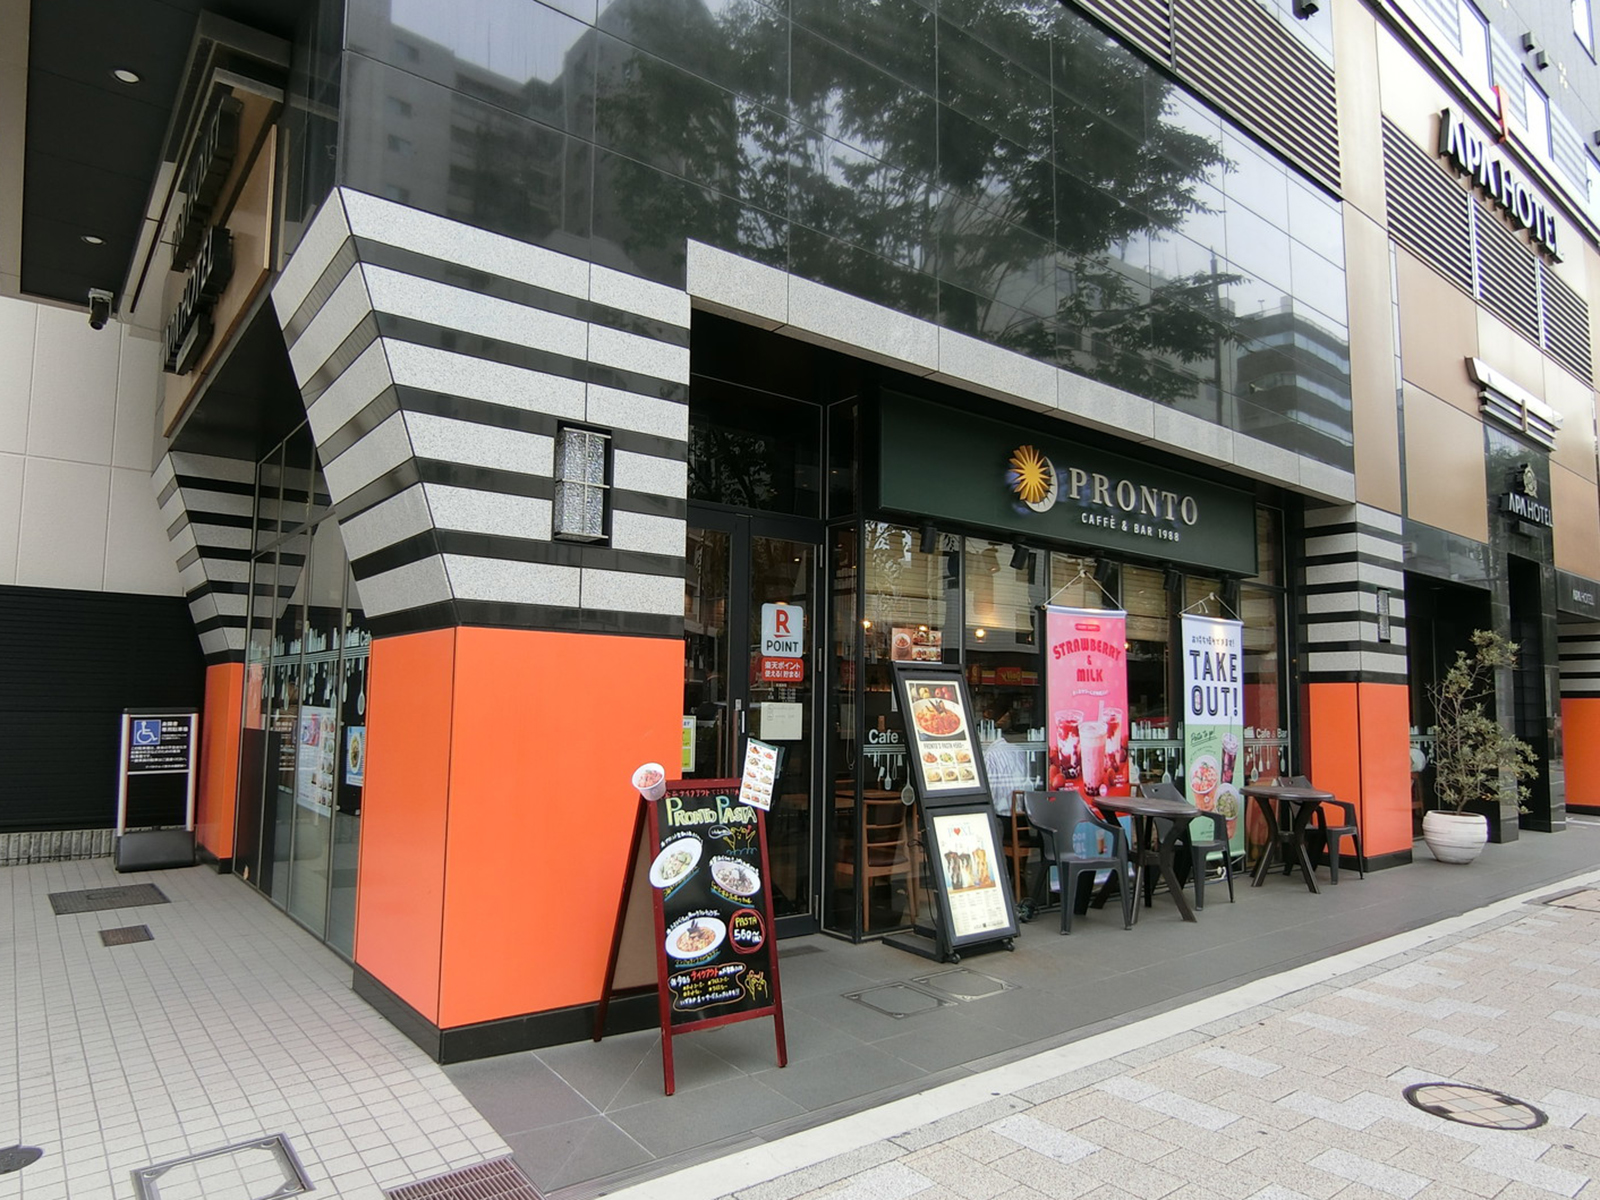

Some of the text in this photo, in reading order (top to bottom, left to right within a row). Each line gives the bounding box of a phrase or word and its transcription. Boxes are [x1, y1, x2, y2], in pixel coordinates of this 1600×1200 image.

[1443, 108, 1563, 262] APA HOTEL
[1069, 467, 1198, 526] PRONTO
[1508, 492, 1554, 528] APA HOTEL
[1081, 511, 1180, 543] CAFFÈ & BAR 1988
[775, 609, 790, 633] R
[766, 640, 799, 653] POINT
[1053, 637, 1121, 661] STRAWBERRY
[765, 661, 801, 671] 楽天ポイント
[1076, 668, 1103, 682] MILK
[1189, 649, 1238, 683] TAKE
[1191, 685, 1238, 717] OUT!
[868, 728, 899, 744] Cafe
[1256, 728, 1271, 739] Cafe
[1277, 728, 1288, 739] Bar
[735, 916, 758, 928] PASTA
